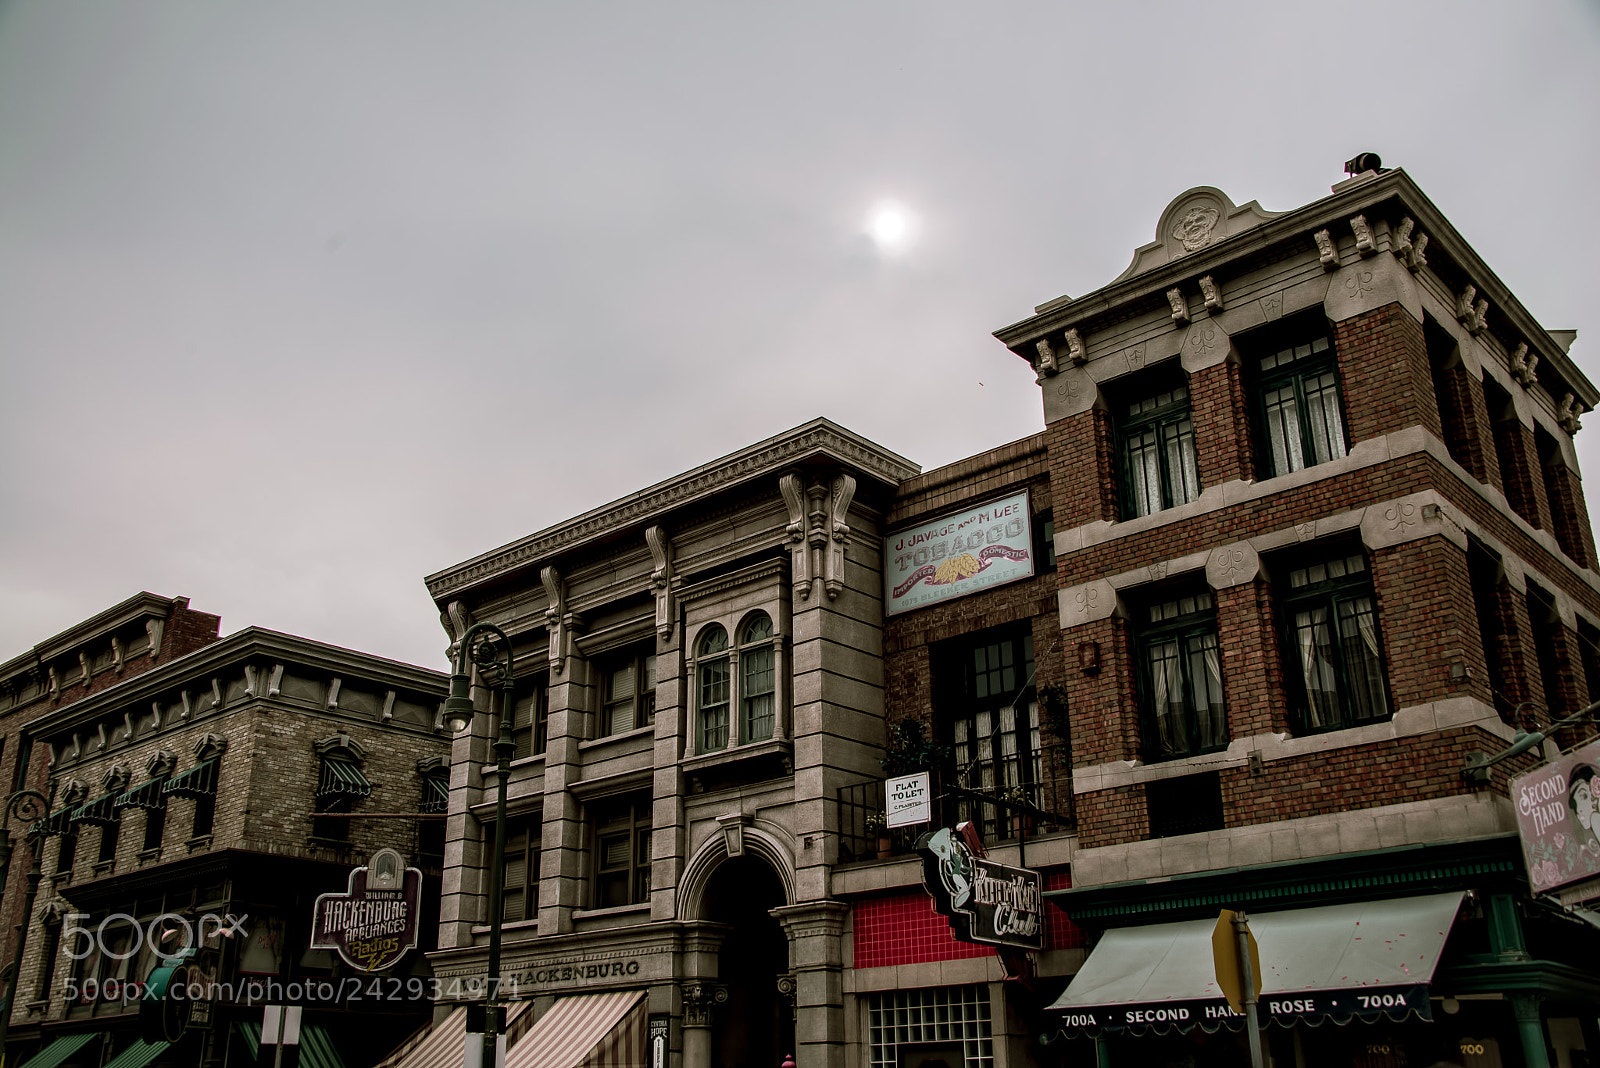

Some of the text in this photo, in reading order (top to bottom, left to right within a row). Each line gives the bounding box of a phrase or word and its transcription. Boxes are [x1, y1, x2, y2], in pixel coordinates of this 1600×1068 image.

[894, 517, 1025, 572] TOBACCO
[895, 539, 906, 552] J.
[907, 524, 955, 548] JAVAGE
[957, 517, 977, 531] AND
[982, 548, 1026, 559] DOMESTIC
[894, 567, 935, 598] IMPORTED
[971, 569, 1018, 588] STREET
[891, 788, 924, 801] TO LET
[895, 780, 919, 792] FLAT
[1519, 774, 1566, 816] SECOND
[1531, 801, 1565, 836] HAND
[323, 900, 408, 934] HACKENBURG
[994, 902, 1038, 937] Club
[345, 919, 406, 943] APPLIANCES
[348, 937, 400, 959] Radios
[511, 962, 639, 987] HACKENBURG
[1062, 993, 1407, 1027] 700A SECOND HAN ROSE 700A
[650, 1027, 668, 1040] HOPE
[1366, 1044, 1390, 1056] 700
[1461, 1044, 1485, 1056] 700
